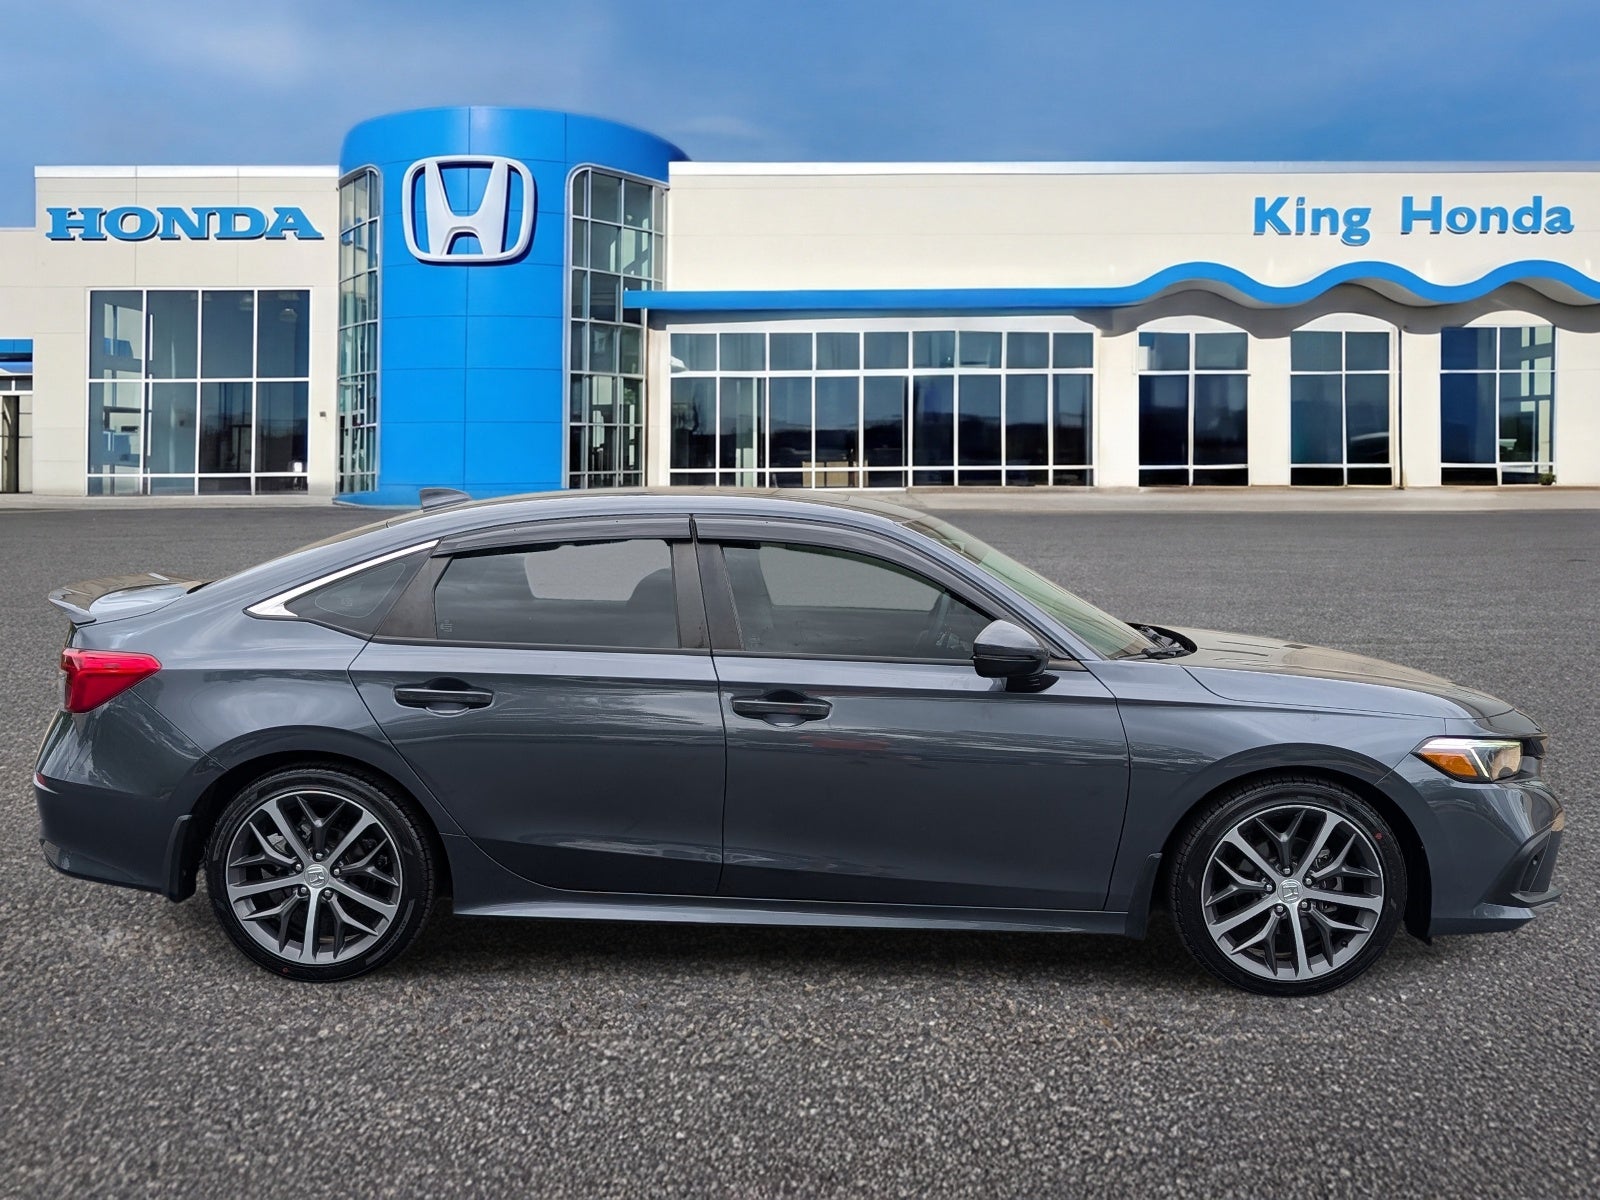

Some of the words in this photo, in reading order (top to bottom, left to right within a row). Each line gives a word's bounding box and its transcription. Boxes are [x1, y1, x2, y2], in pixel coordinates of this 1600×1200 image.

[46, 206, 324, 241] HONDA
[1254, 196, 1371, 246] King
[1401, 195, 1575, 235] Honda
